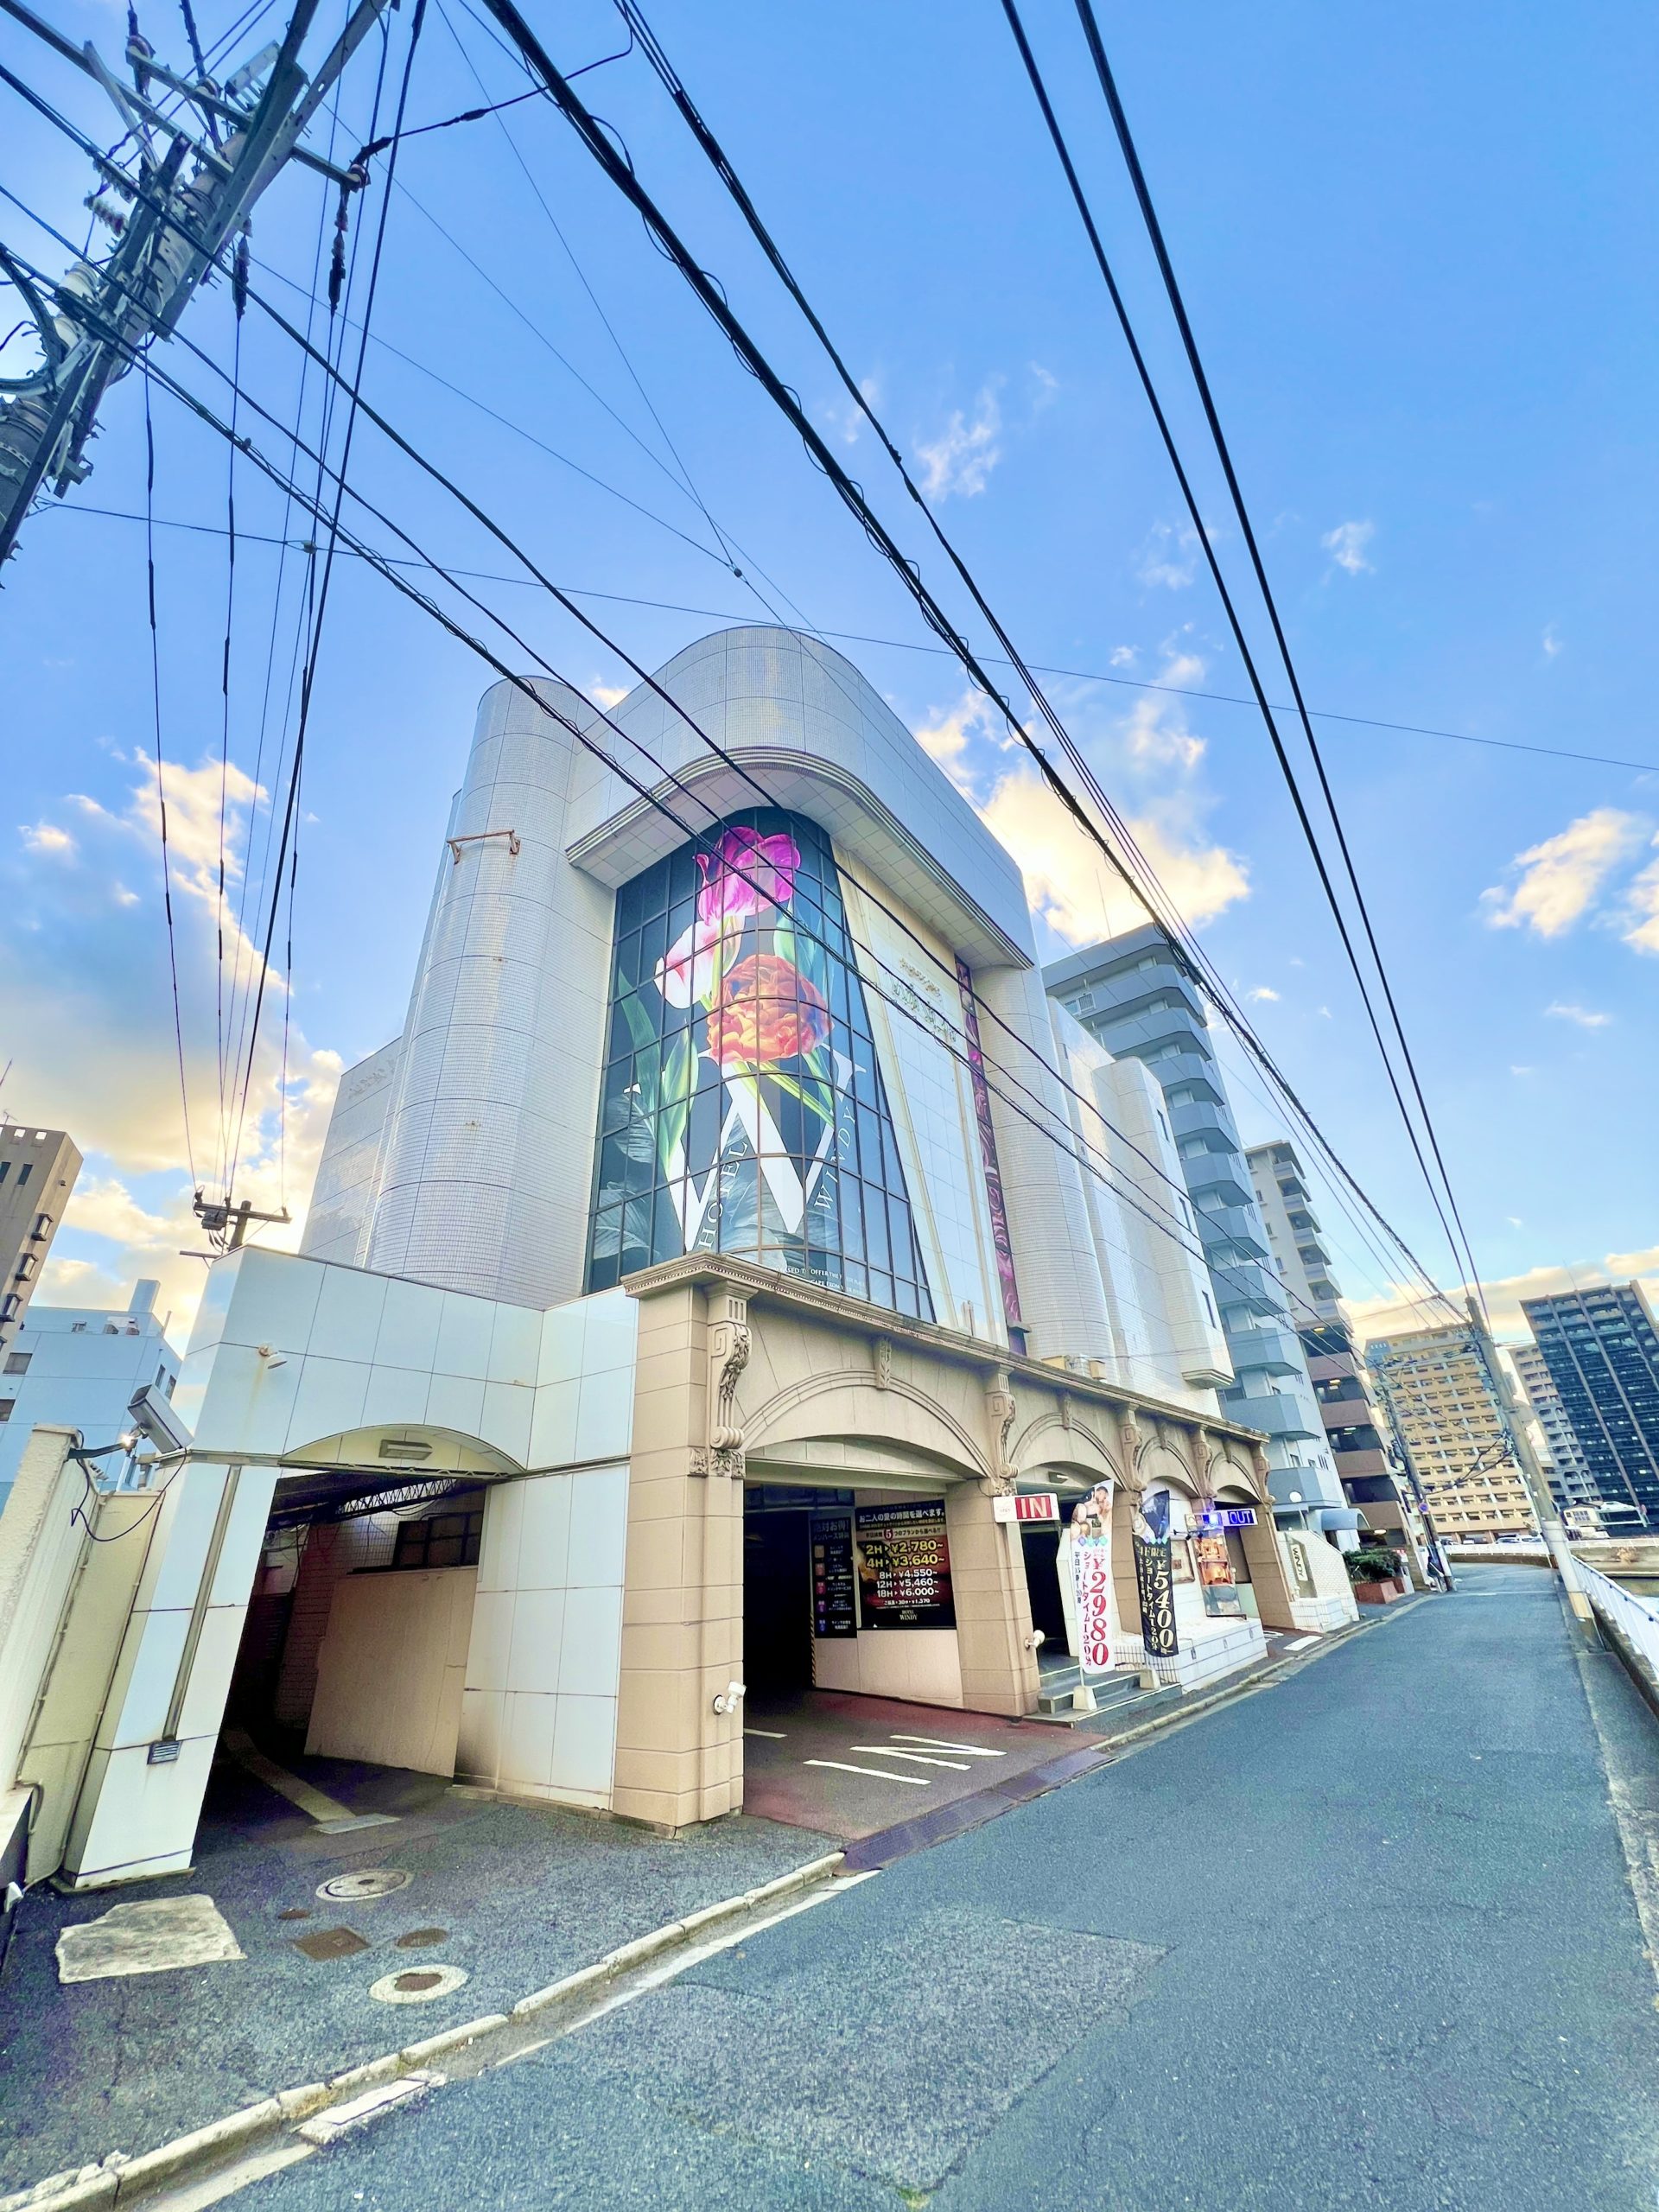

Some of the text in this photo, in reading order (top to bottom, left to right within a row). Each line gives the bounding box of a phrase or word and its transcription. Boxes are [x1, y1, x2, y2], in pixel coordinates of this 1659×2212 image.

[814, 1106, 857, 1211] WINDY
[697, 1141, 749, 1250] HOTEL
[1020, 1496, 1048, 1519] IN
[1228, 1510, 1251, 1524] OUT
[886, 1529, 892, 1538] 5
[866, 1544, 882, 1554] 2H
[867, 1558, 884, 1568] 4H
[879, 1571, 893, 1580] 8H
[877, 1589, 893, 1598] 18H
[1090, 1558, 1109, 1666] ¥2980
